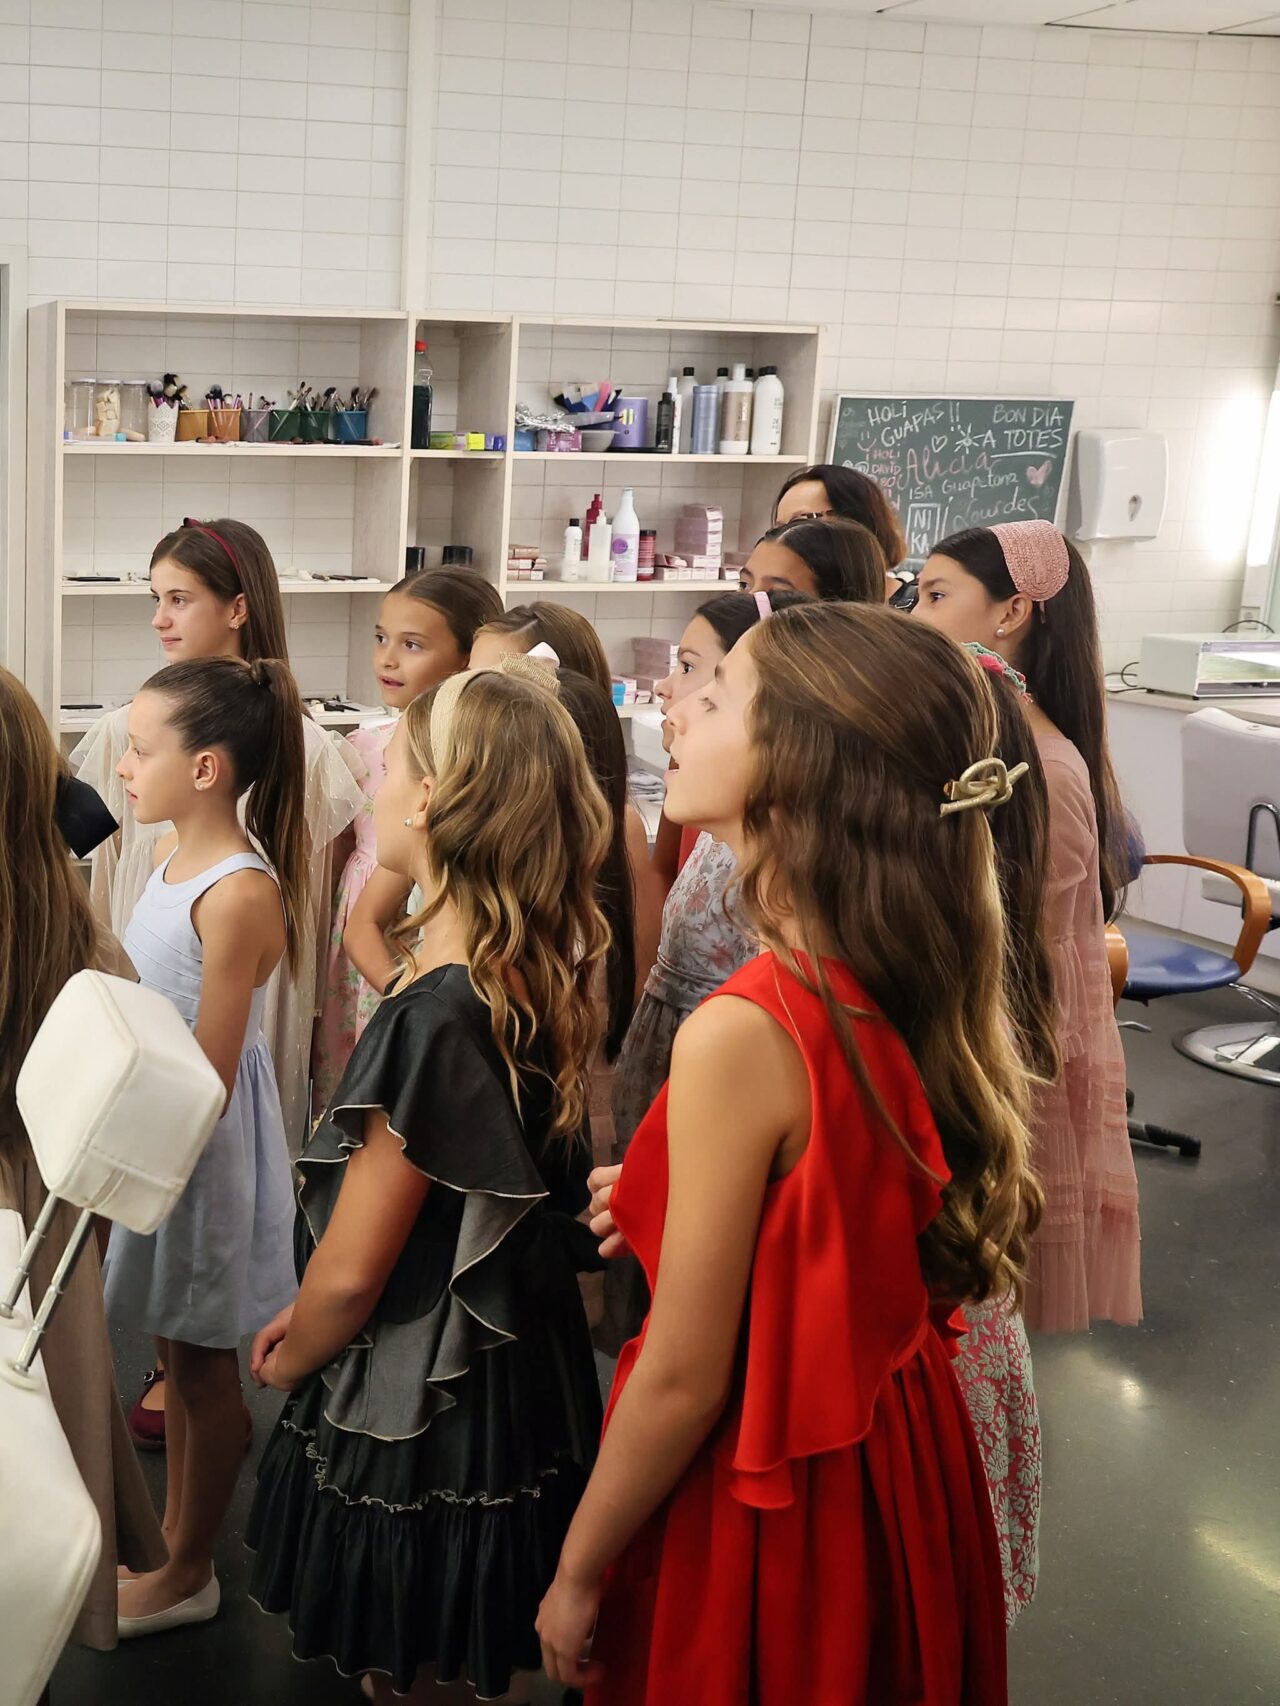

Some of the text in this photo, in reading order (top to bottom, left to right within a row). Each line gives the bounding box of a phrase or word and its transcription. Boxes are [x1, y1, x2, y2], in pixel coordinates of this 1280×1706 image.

[881, 401, 944, 447] GUAPAS
[992, 403, 1027, 424] BON
[982, 428, 1063, 450] A TOTES
